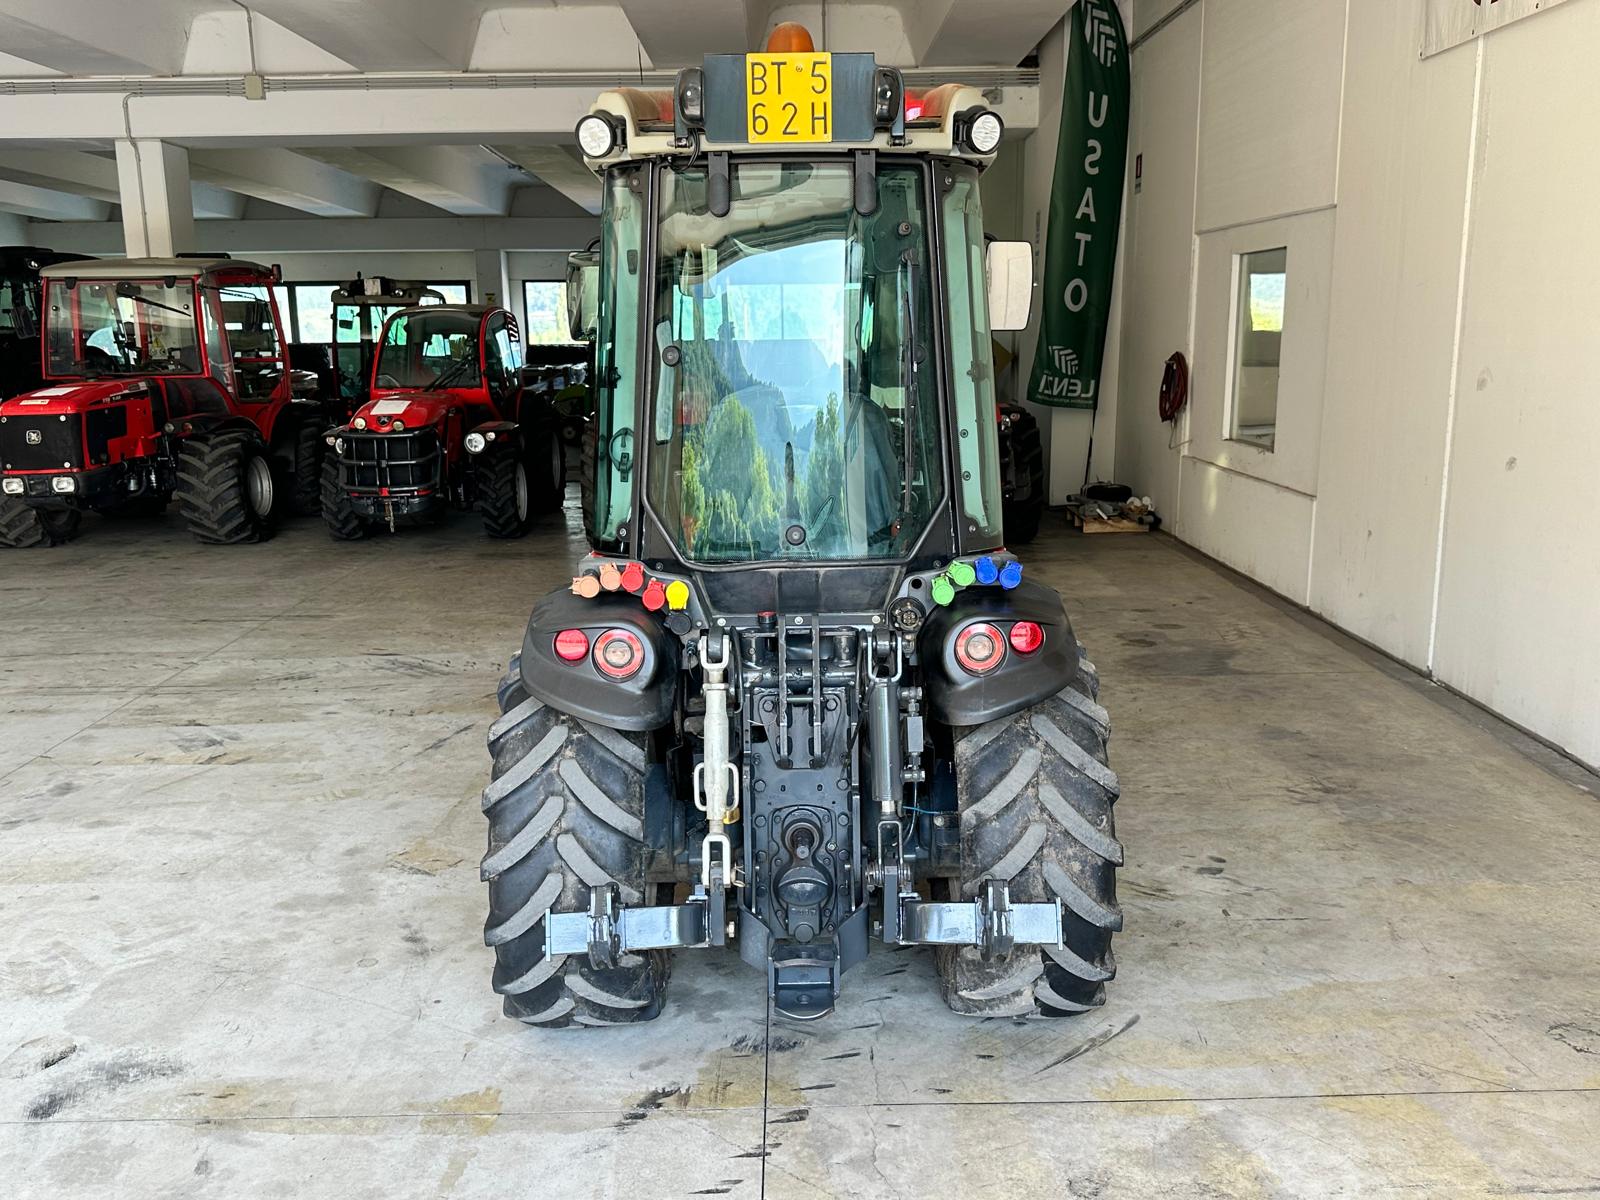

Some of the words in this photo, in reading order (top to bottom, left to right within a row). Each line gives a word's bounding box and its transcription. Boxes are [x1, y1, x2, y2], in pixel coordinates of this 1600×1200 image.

[751, 61, 787, 95] BT
[811, 60, 827, 94] 5
[752, 102, 828, 135] 62H
